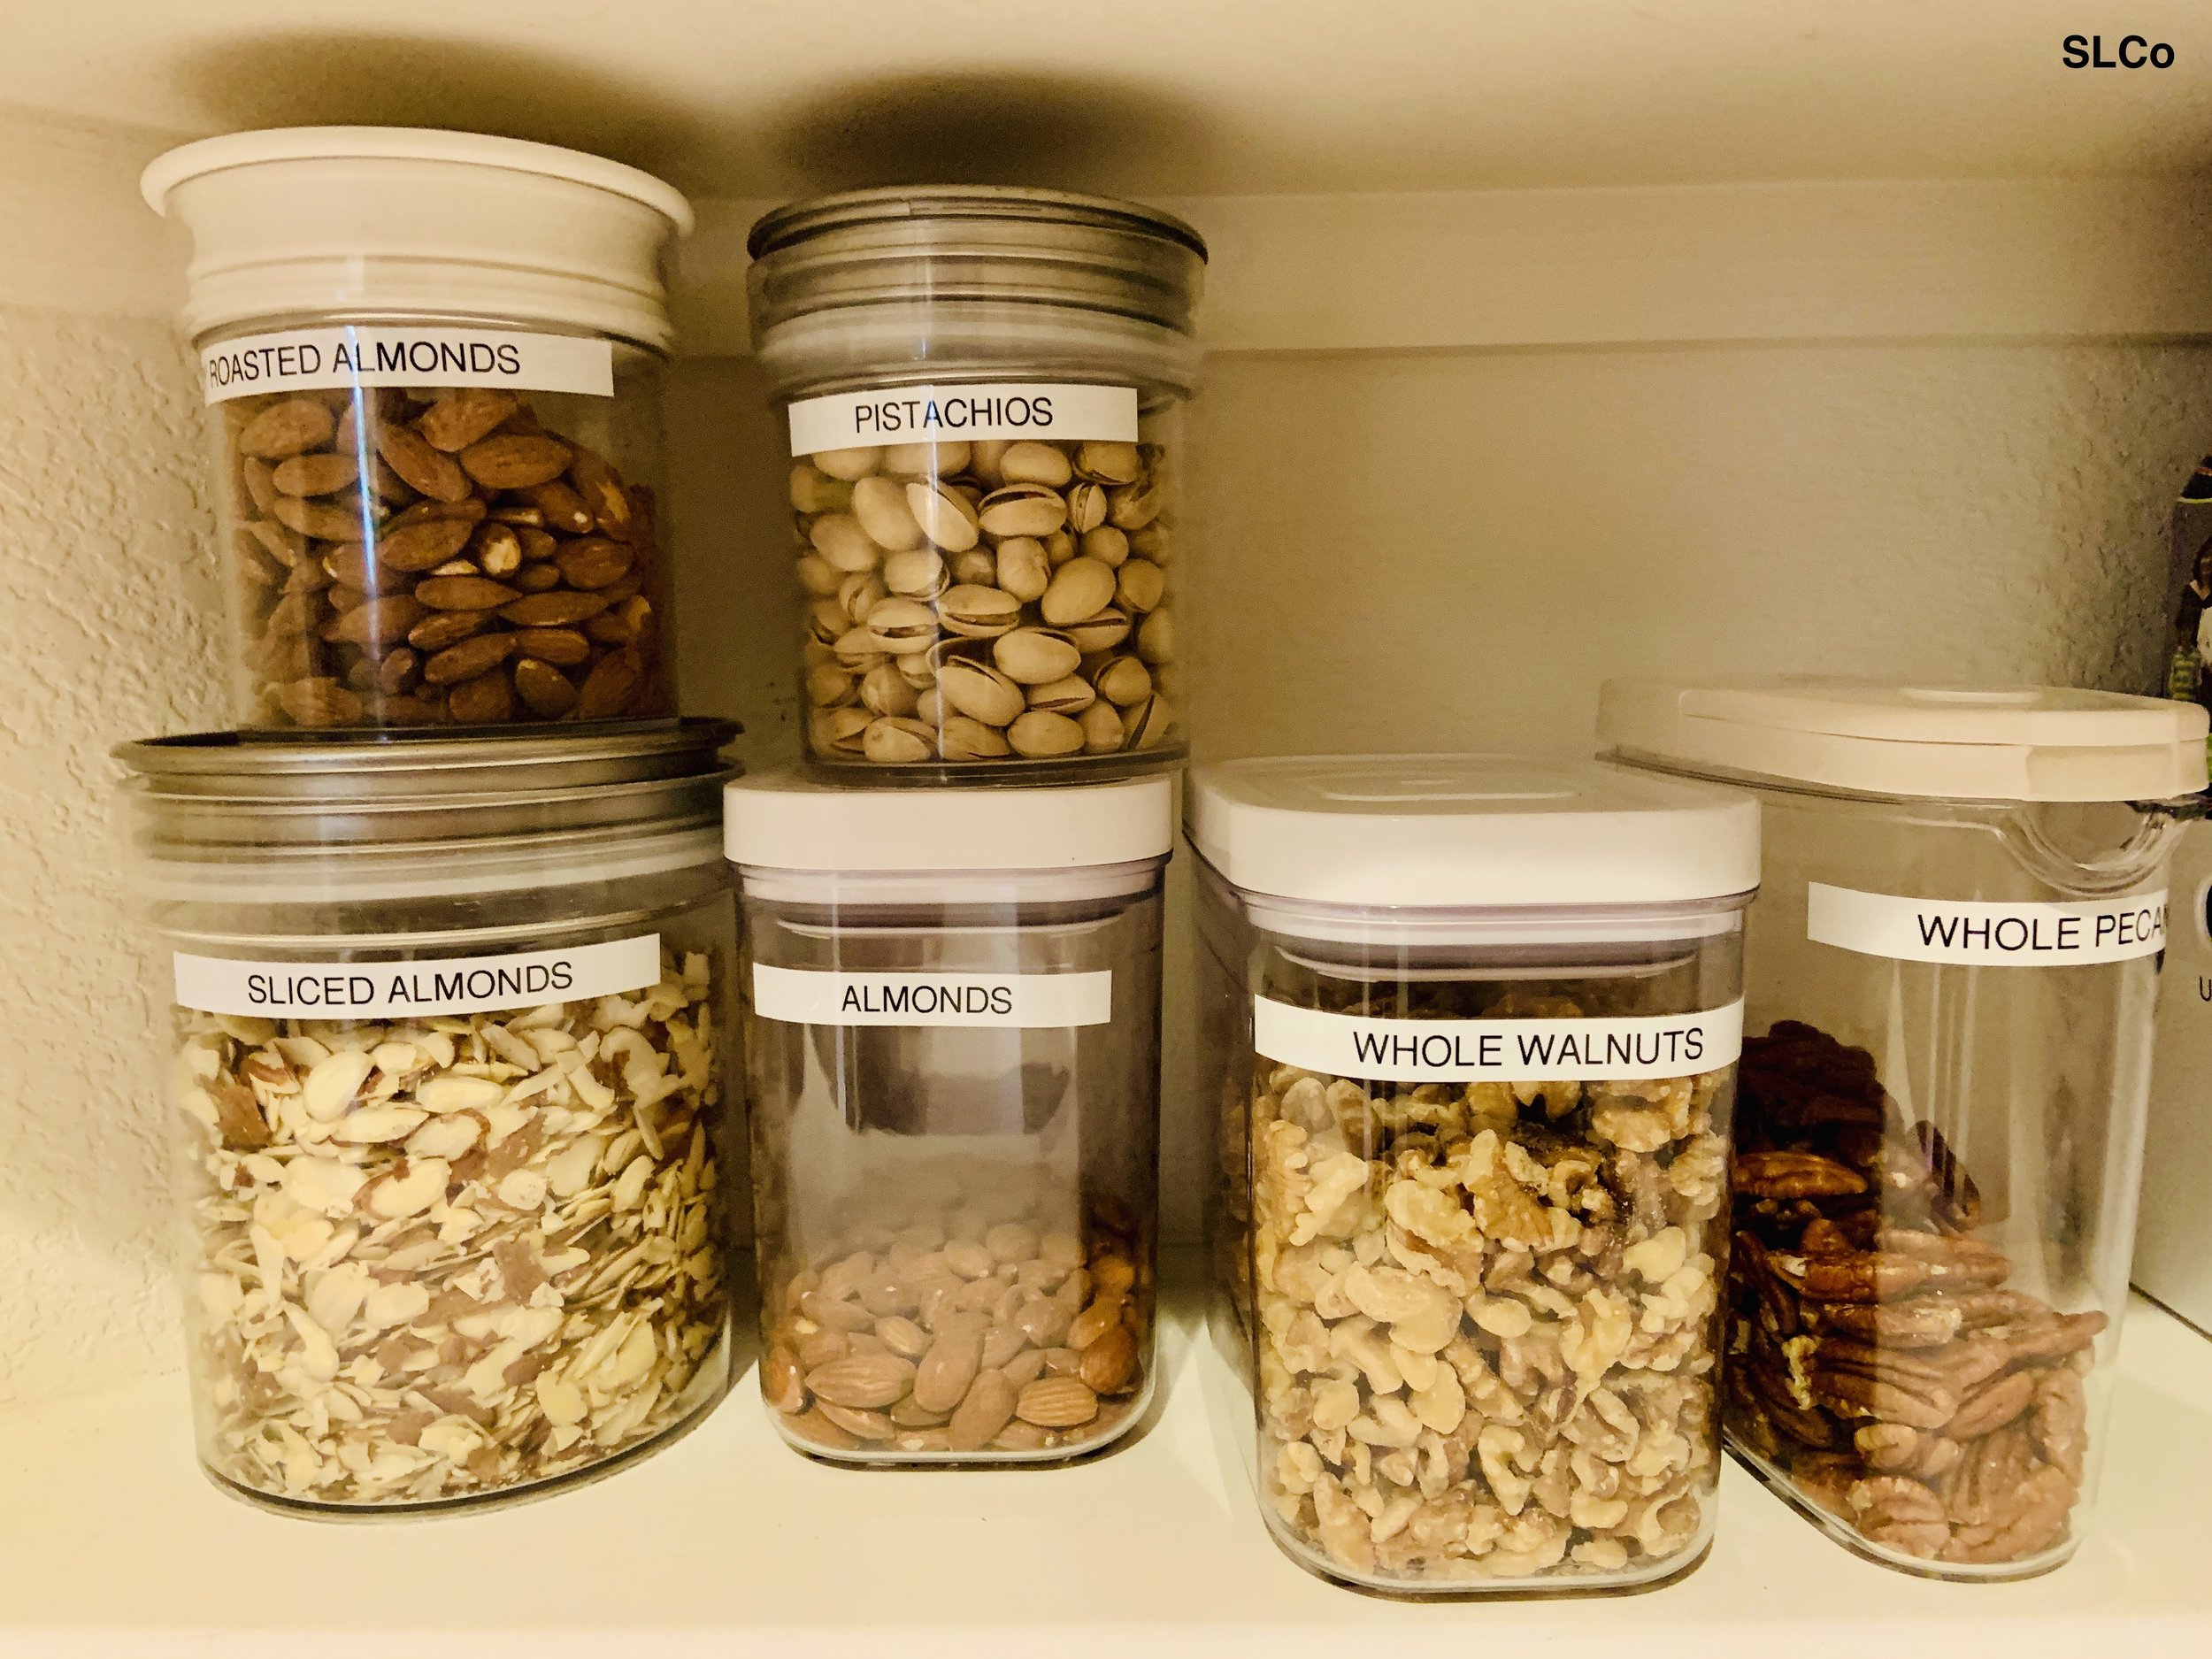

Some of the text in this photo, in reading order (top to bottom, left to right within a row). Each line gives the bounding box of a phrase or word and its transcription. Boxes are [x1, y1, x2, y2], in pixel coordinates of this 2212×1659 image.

[209, 340, 521, 388] ROASTED ALMONDS
[855, 396, 1053, 433] PISTACHIOS
[1917, 914, 2081, 951] WHOLE
[248, 961, 574, 1006] SLICED ALMONDS
[841, 985, 1012, 1014] ALMONDS
[1353, 1027, 1704, 1068] WHOLE WALNUTS
